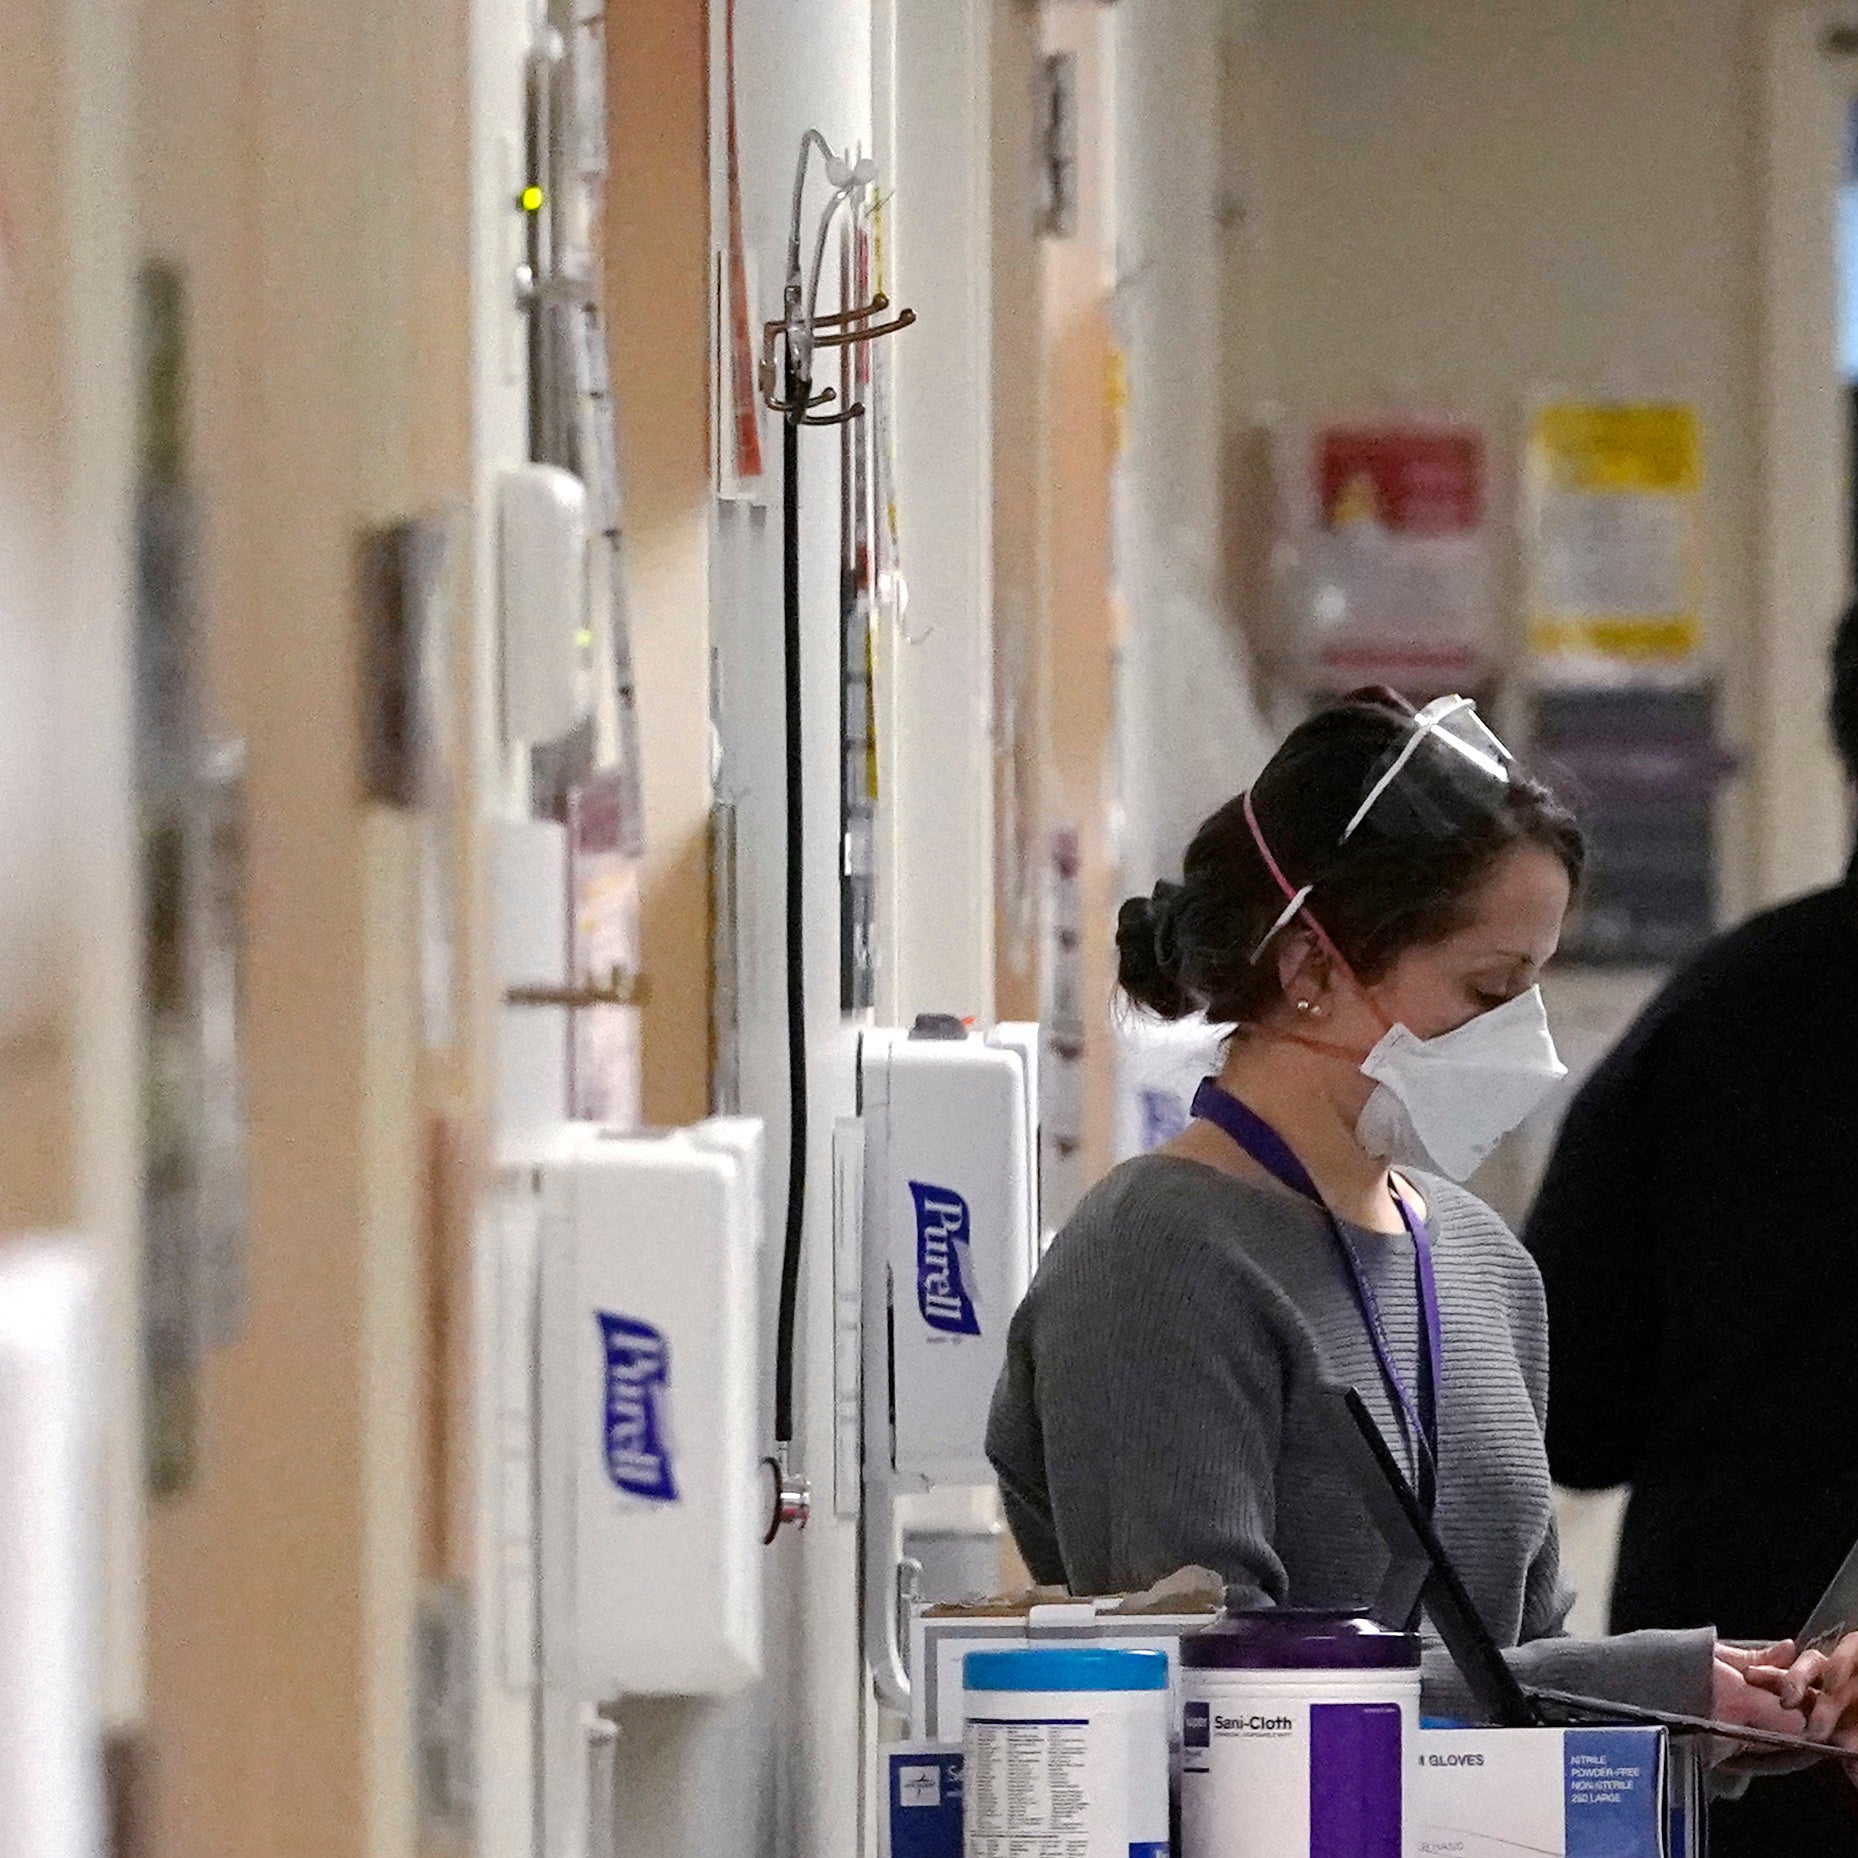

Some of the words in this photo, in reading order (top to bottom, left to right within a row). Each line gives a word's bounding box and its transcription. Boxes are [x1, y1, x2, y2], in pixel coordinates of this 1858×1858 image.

[1214, 1715, 1293, 1730] Sani-Cloth
[1429, 1754, 1485, 1767] GLOVES
[1570, 1755, 1608, 1766] NITRILE
[1570, 1767, 1641, 1778] POWDER-FREE
[1570, 1780, 1635, 1791] NON-STERILE
